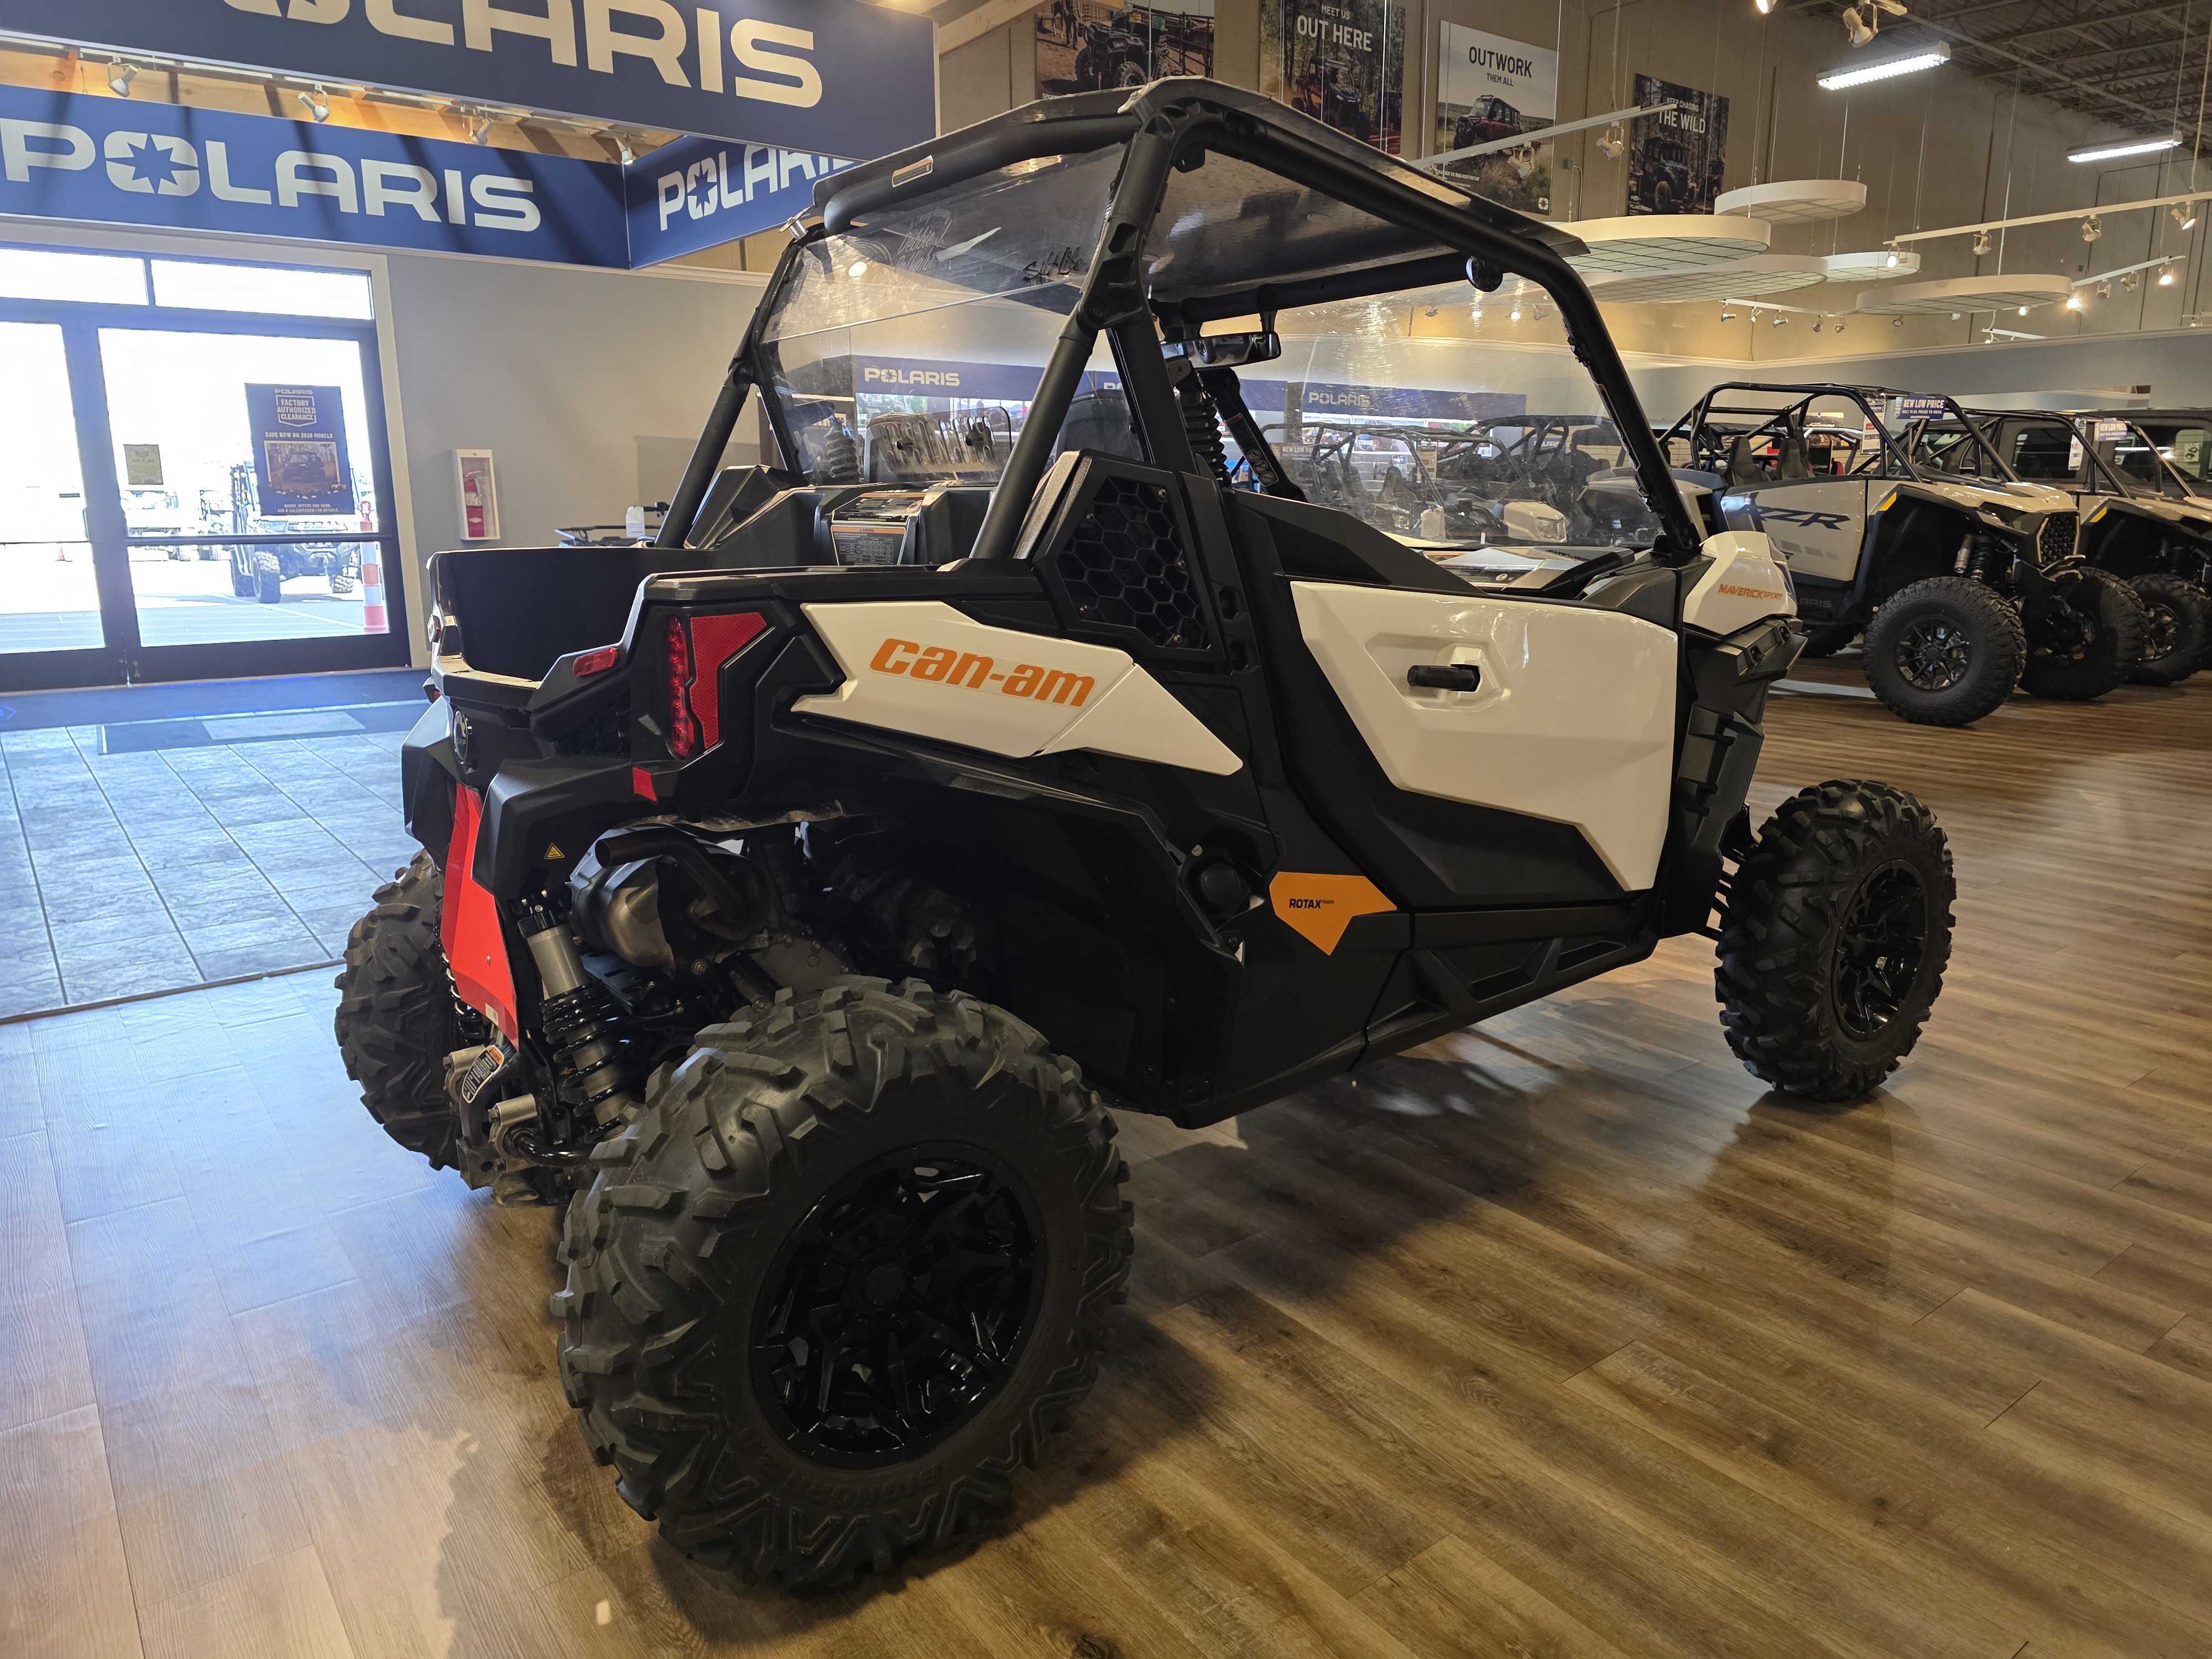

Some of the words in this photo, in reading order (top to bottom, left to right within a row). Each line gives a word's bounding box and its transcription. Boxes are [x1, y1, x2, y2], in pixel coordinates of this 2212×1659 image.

[1322, 4, 1339, 17] MEET
[1341, 10, 1350, 20] US
[1297, 15, 1328, 40] OUT
[1333, 23, 1373, 52] HERE
[1469, 46, 1532, 78] OUTWORK
[1486, 73, 1501, 84] THEM
[1503, 77, 1514, 86] ALL
[1679, 101, 1699, 112] CHASING
[1659, 109, 1678, 127] THE
[1681, 113, 1705, 133] WILD
[0, 118, 541, 232] POLARIS
[864, 367, 961, 387] POLARIS
[1309, 392, 1370, 407] POLARIS
[1903, 399, 1914, 408] NEW
[1914, 399, 1927, 408] LOW
[1927, 399, 1945, 409] PRICE
[1718, 583, 1766, 599] MAVERICK
[1763, 592, 1783, 600] SPORT
[869, 638, 1096, 708] can-am
[1288, 898, 1322, 909] ROTAX
